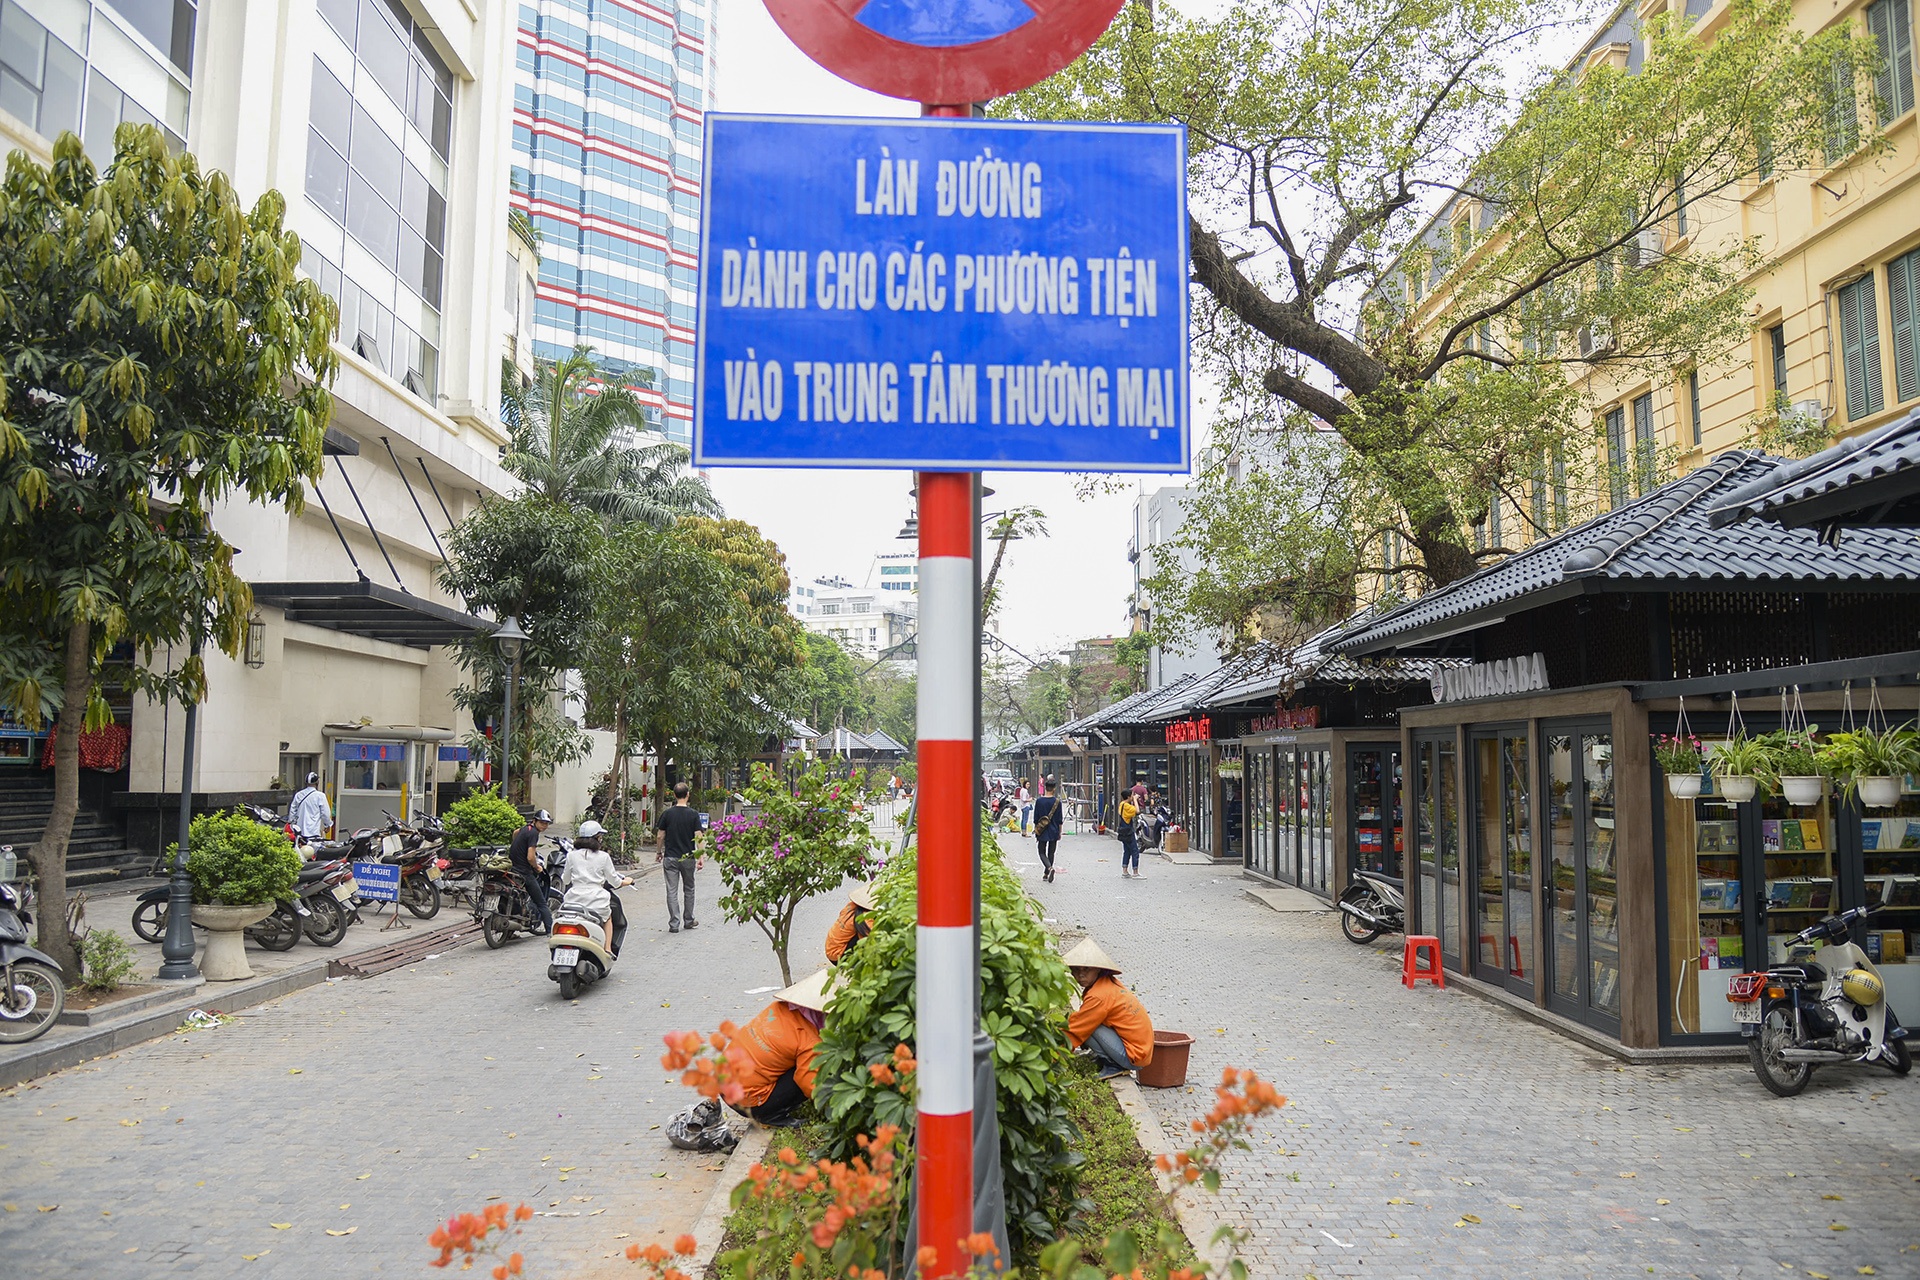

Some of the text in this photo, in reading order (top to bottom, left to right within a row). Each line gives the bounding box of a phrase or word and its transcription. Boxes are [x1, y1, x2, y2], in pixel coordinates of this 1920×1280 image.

[856, 146, 1042, 219] LÀN ĐƯỜNG
[722, 236, 1158, 329] DÀNH CHO CÁC PHƯƠNG TIỆN
[724, 347, 1175, 440] VÀO TRUNG TÂM THƯƠNG MẠI
[1443, 652, 1548, 703] XUNHASABA
